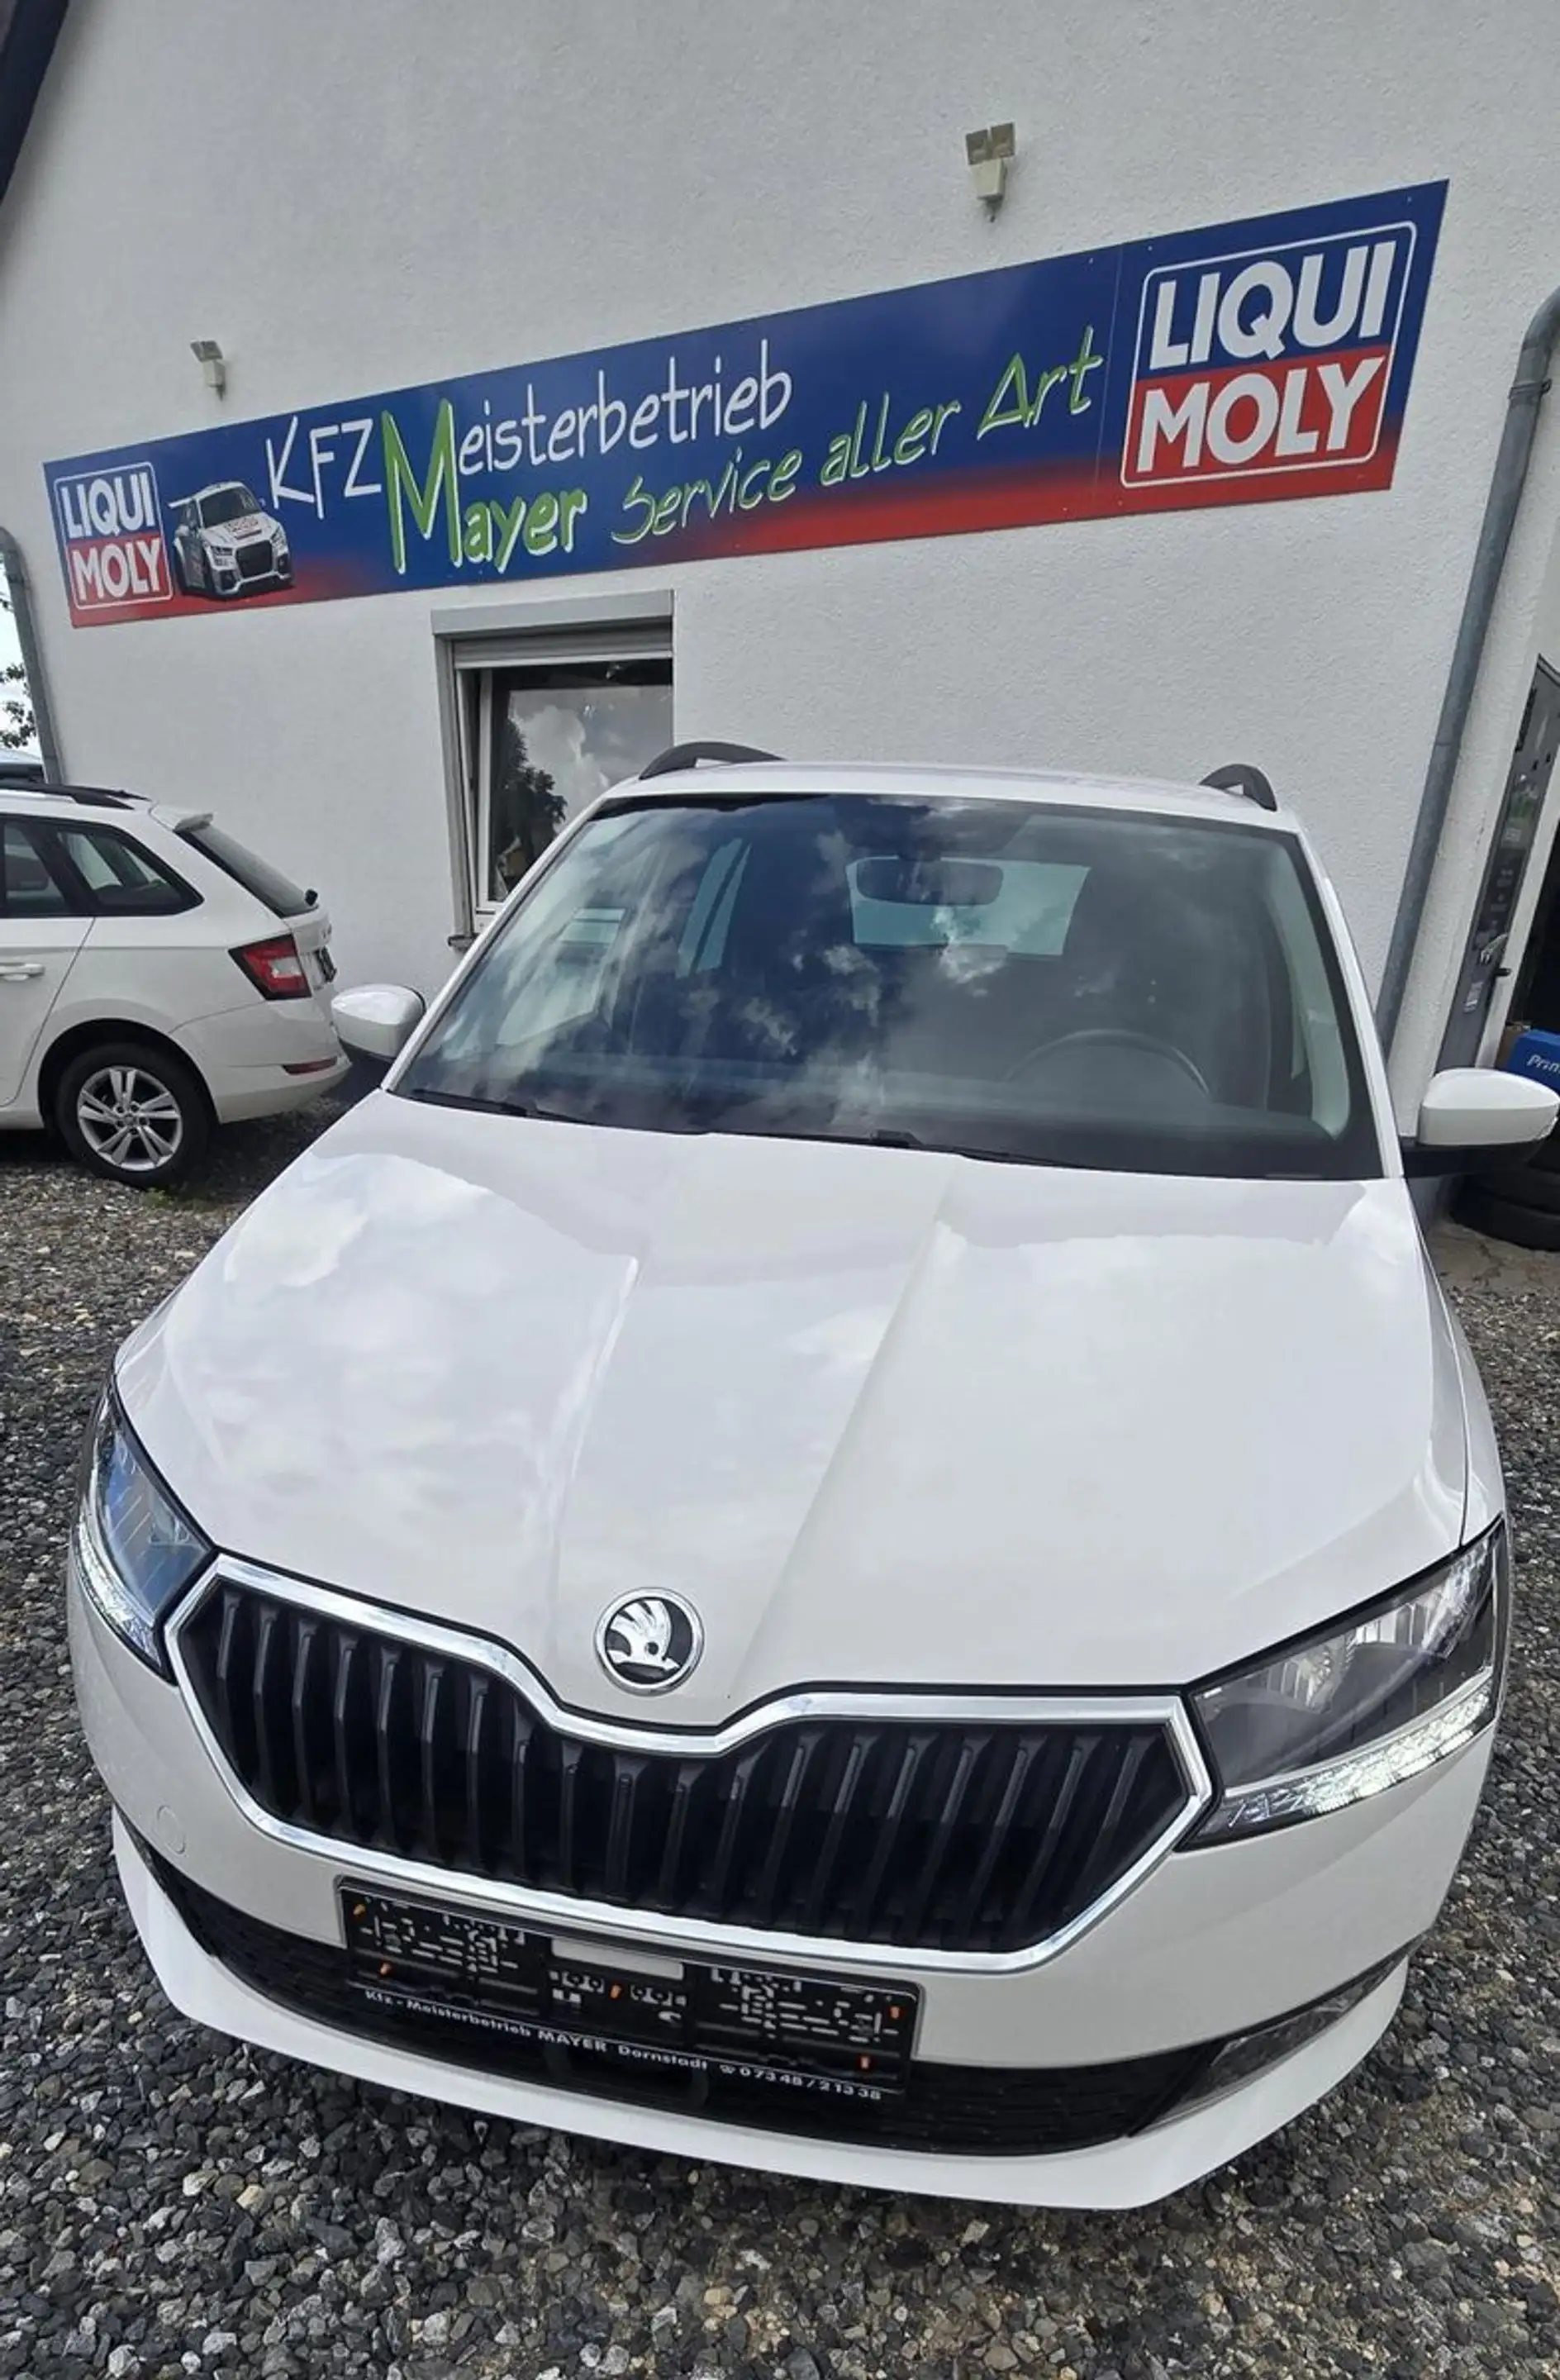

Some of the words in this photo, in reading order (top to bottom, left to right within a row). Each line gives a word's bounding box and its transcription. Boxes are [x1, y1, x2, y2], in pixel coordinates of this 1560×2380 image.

[1149, 240, 1396, 369] LIQUI
[611, 446, 802, 544] Service
[820, 391, 962, 486] aller
[977, 325, 1104, 440] Art
[1136, 355, 1386, 473] MOLY
[60, 472, 155, 538] LIQUI
[265, 416, 382, 520] KFZ
[72, 537, 160, 601] MOLY
[538, 2030, 607, 2053] MAYER
[617, 2044, 707, 2070] Dornstadt
